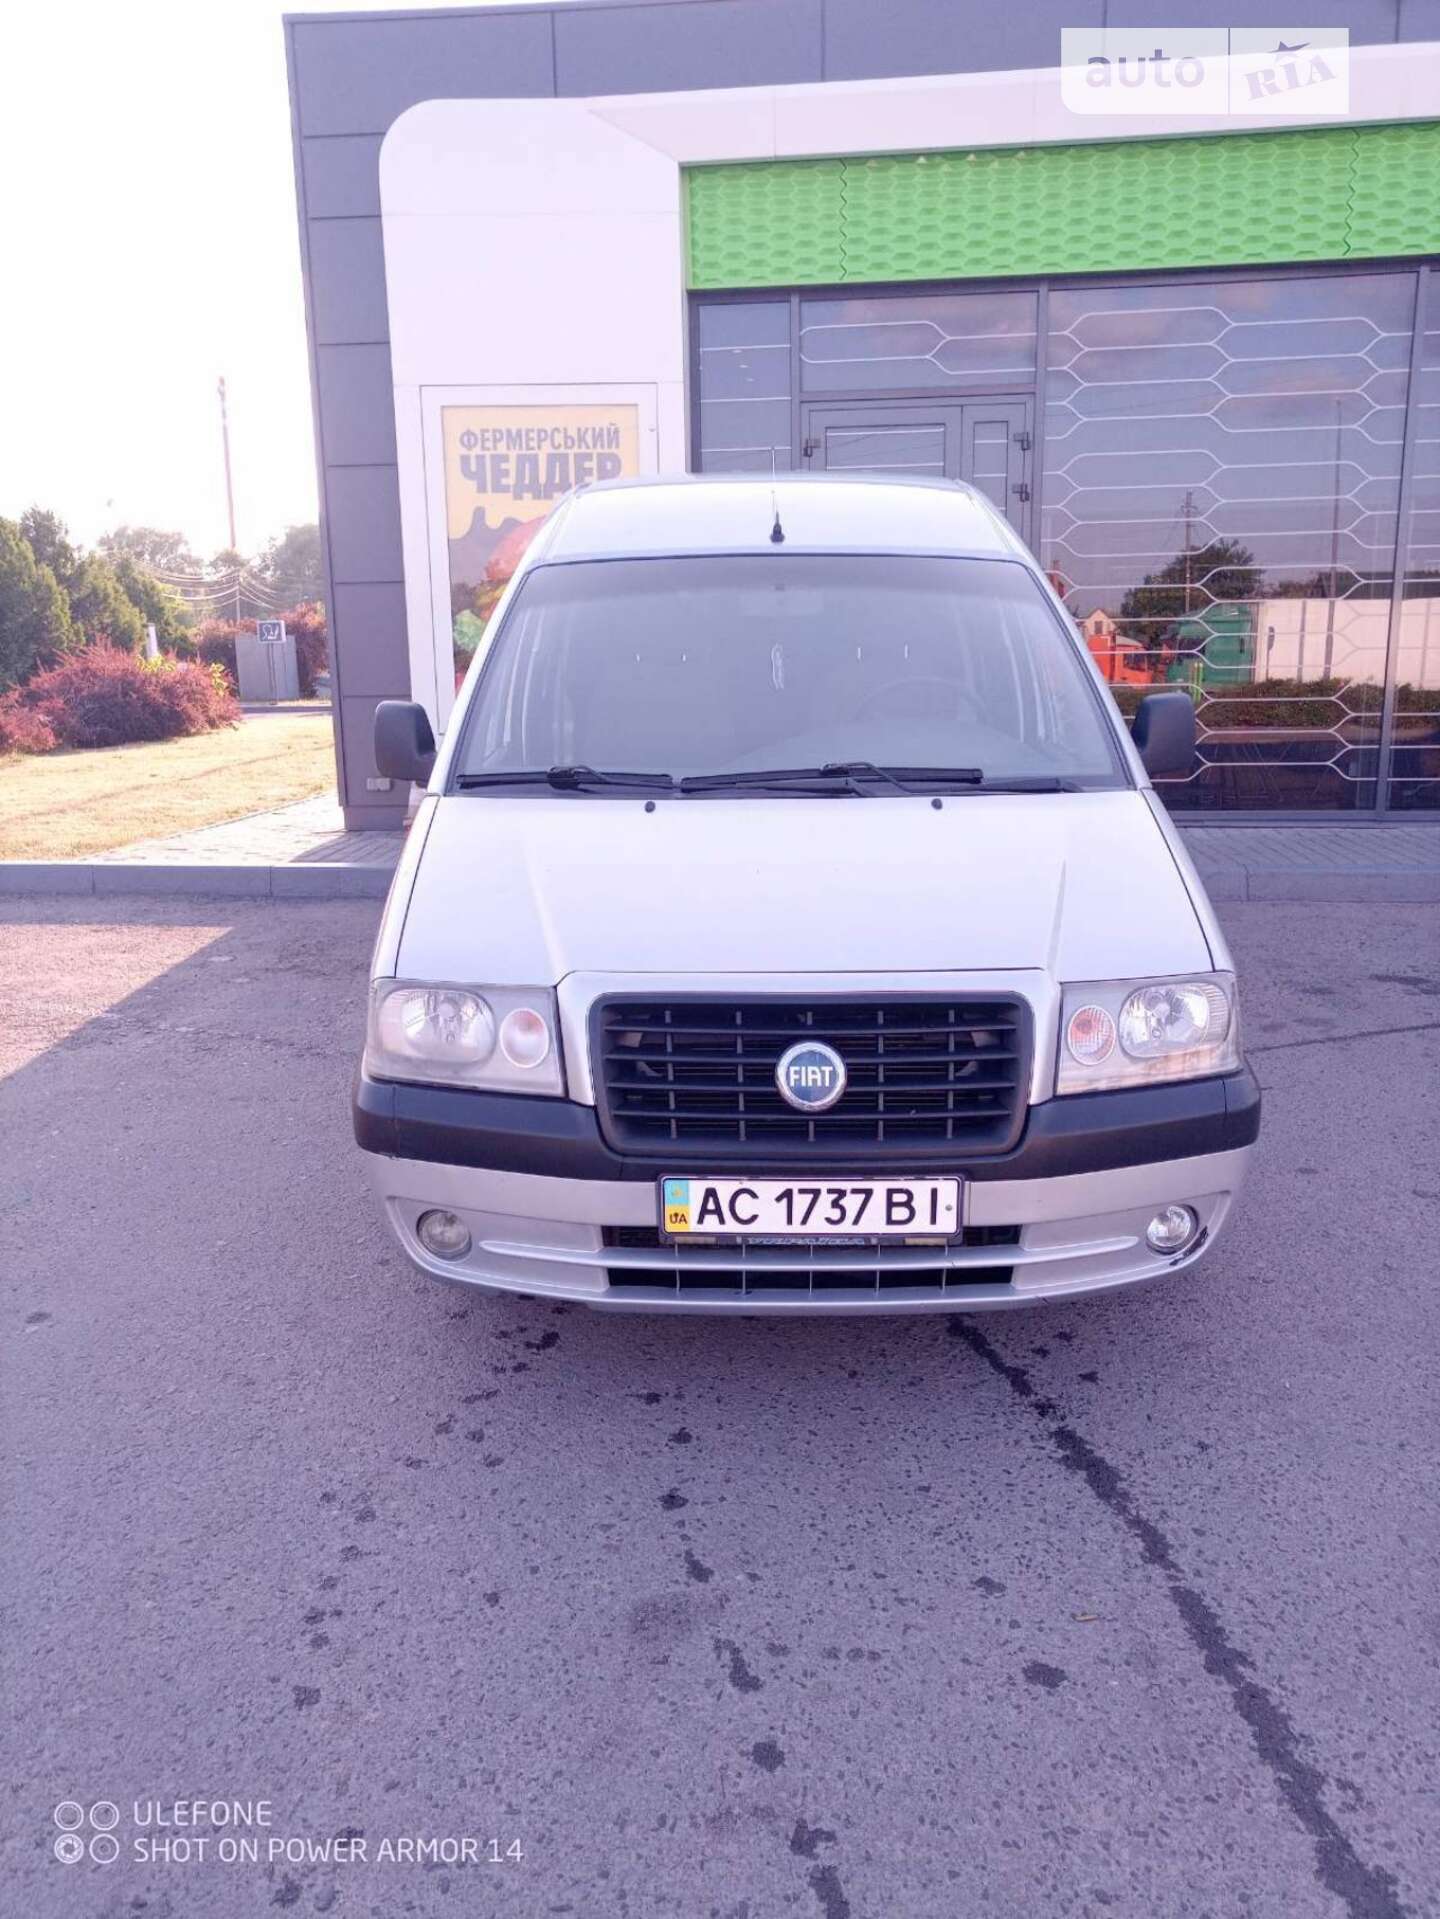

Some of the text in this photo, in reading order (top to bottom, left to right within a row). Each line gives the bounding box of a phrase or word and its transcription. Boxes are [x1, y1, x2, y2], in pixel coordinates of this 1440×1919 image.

[459, 423, 621, 451] ФЕРМЕРСЬКИЙ
[789, 1066, 834, 1087] FIAT
[696, 1187, 938, 1226] AC 1737 BI
[669, 1213, 688, 1225] UA
